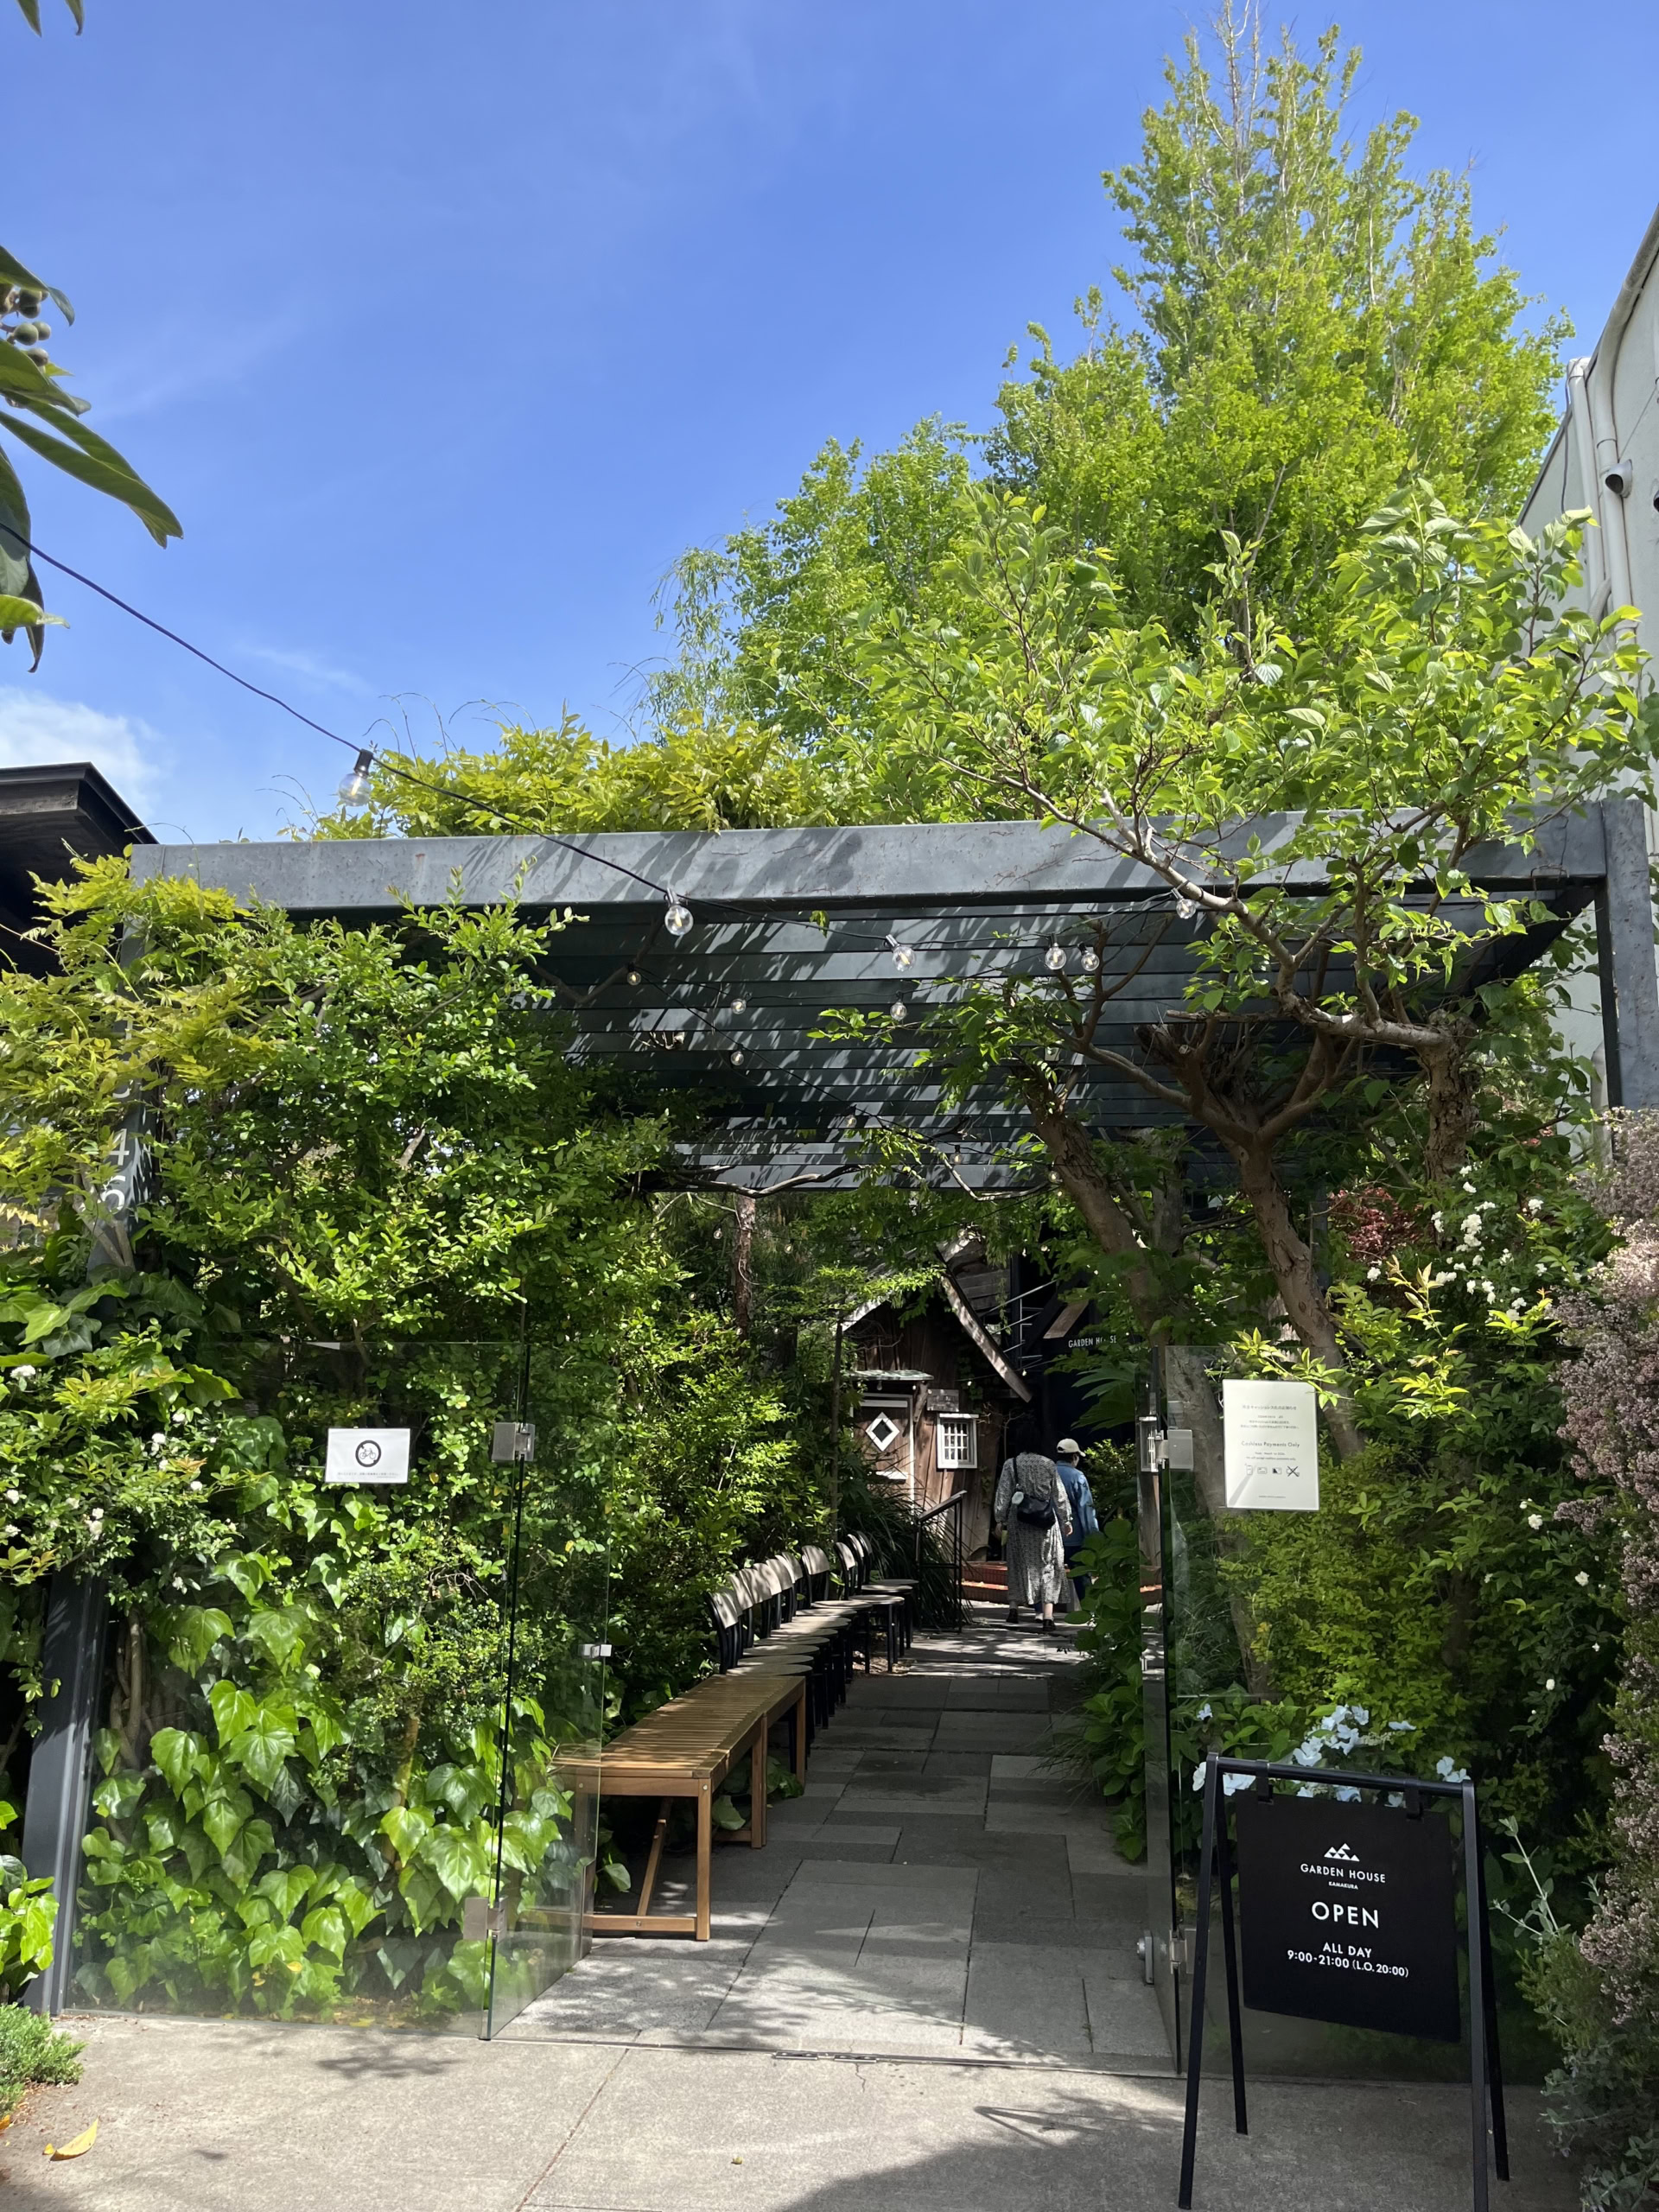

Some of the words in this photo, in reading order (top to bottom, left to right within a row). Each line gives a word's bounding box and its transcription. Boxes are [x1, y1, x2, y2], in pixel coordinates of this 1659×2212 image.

[1068, 1338, 1093, 1348] GARDEN
[1096, 1335, 1117, 1345] HSE
[1300, 1863, 1344, 1877] GARDEN
[1349, 1870, 1386, 1883] HOUSE
[1328, 1881, 1358, 1890] KAMAKURA
[1312, 1901, 1379, 1929] OPEN
[1287, 1949, 1350, 1968] 9:00-21:00
[1323, 1942, 1344, 1954] ALL
[1348, 1945, 1372, 1958] DAY
